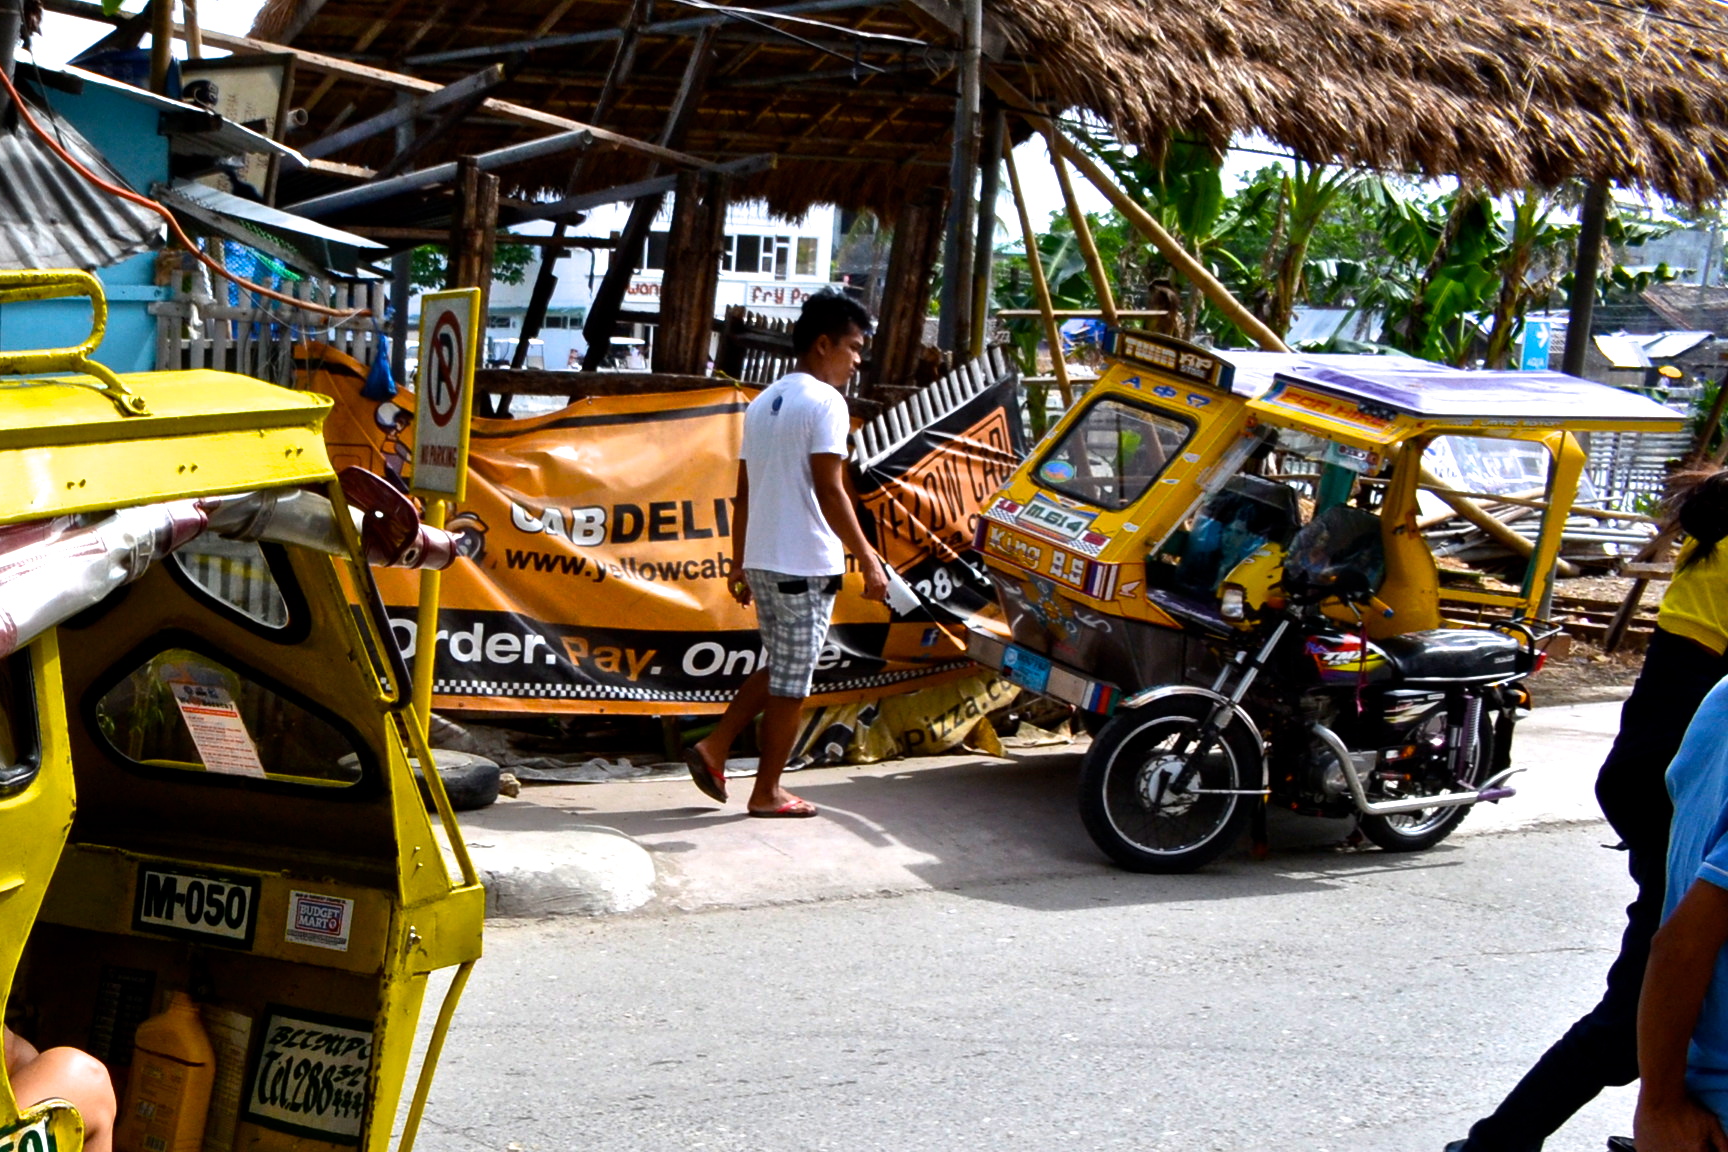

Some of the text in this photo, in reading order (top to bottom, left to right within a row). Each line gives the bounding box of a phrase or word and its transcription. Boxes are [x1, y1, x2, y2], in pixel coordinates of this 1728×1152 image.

[990, 526, 1041, 569] King
[561, 636, 663, 682] Pay.
[144, 874, 246, 929] M-050
[300, 905, 340, 918] BUDGET
